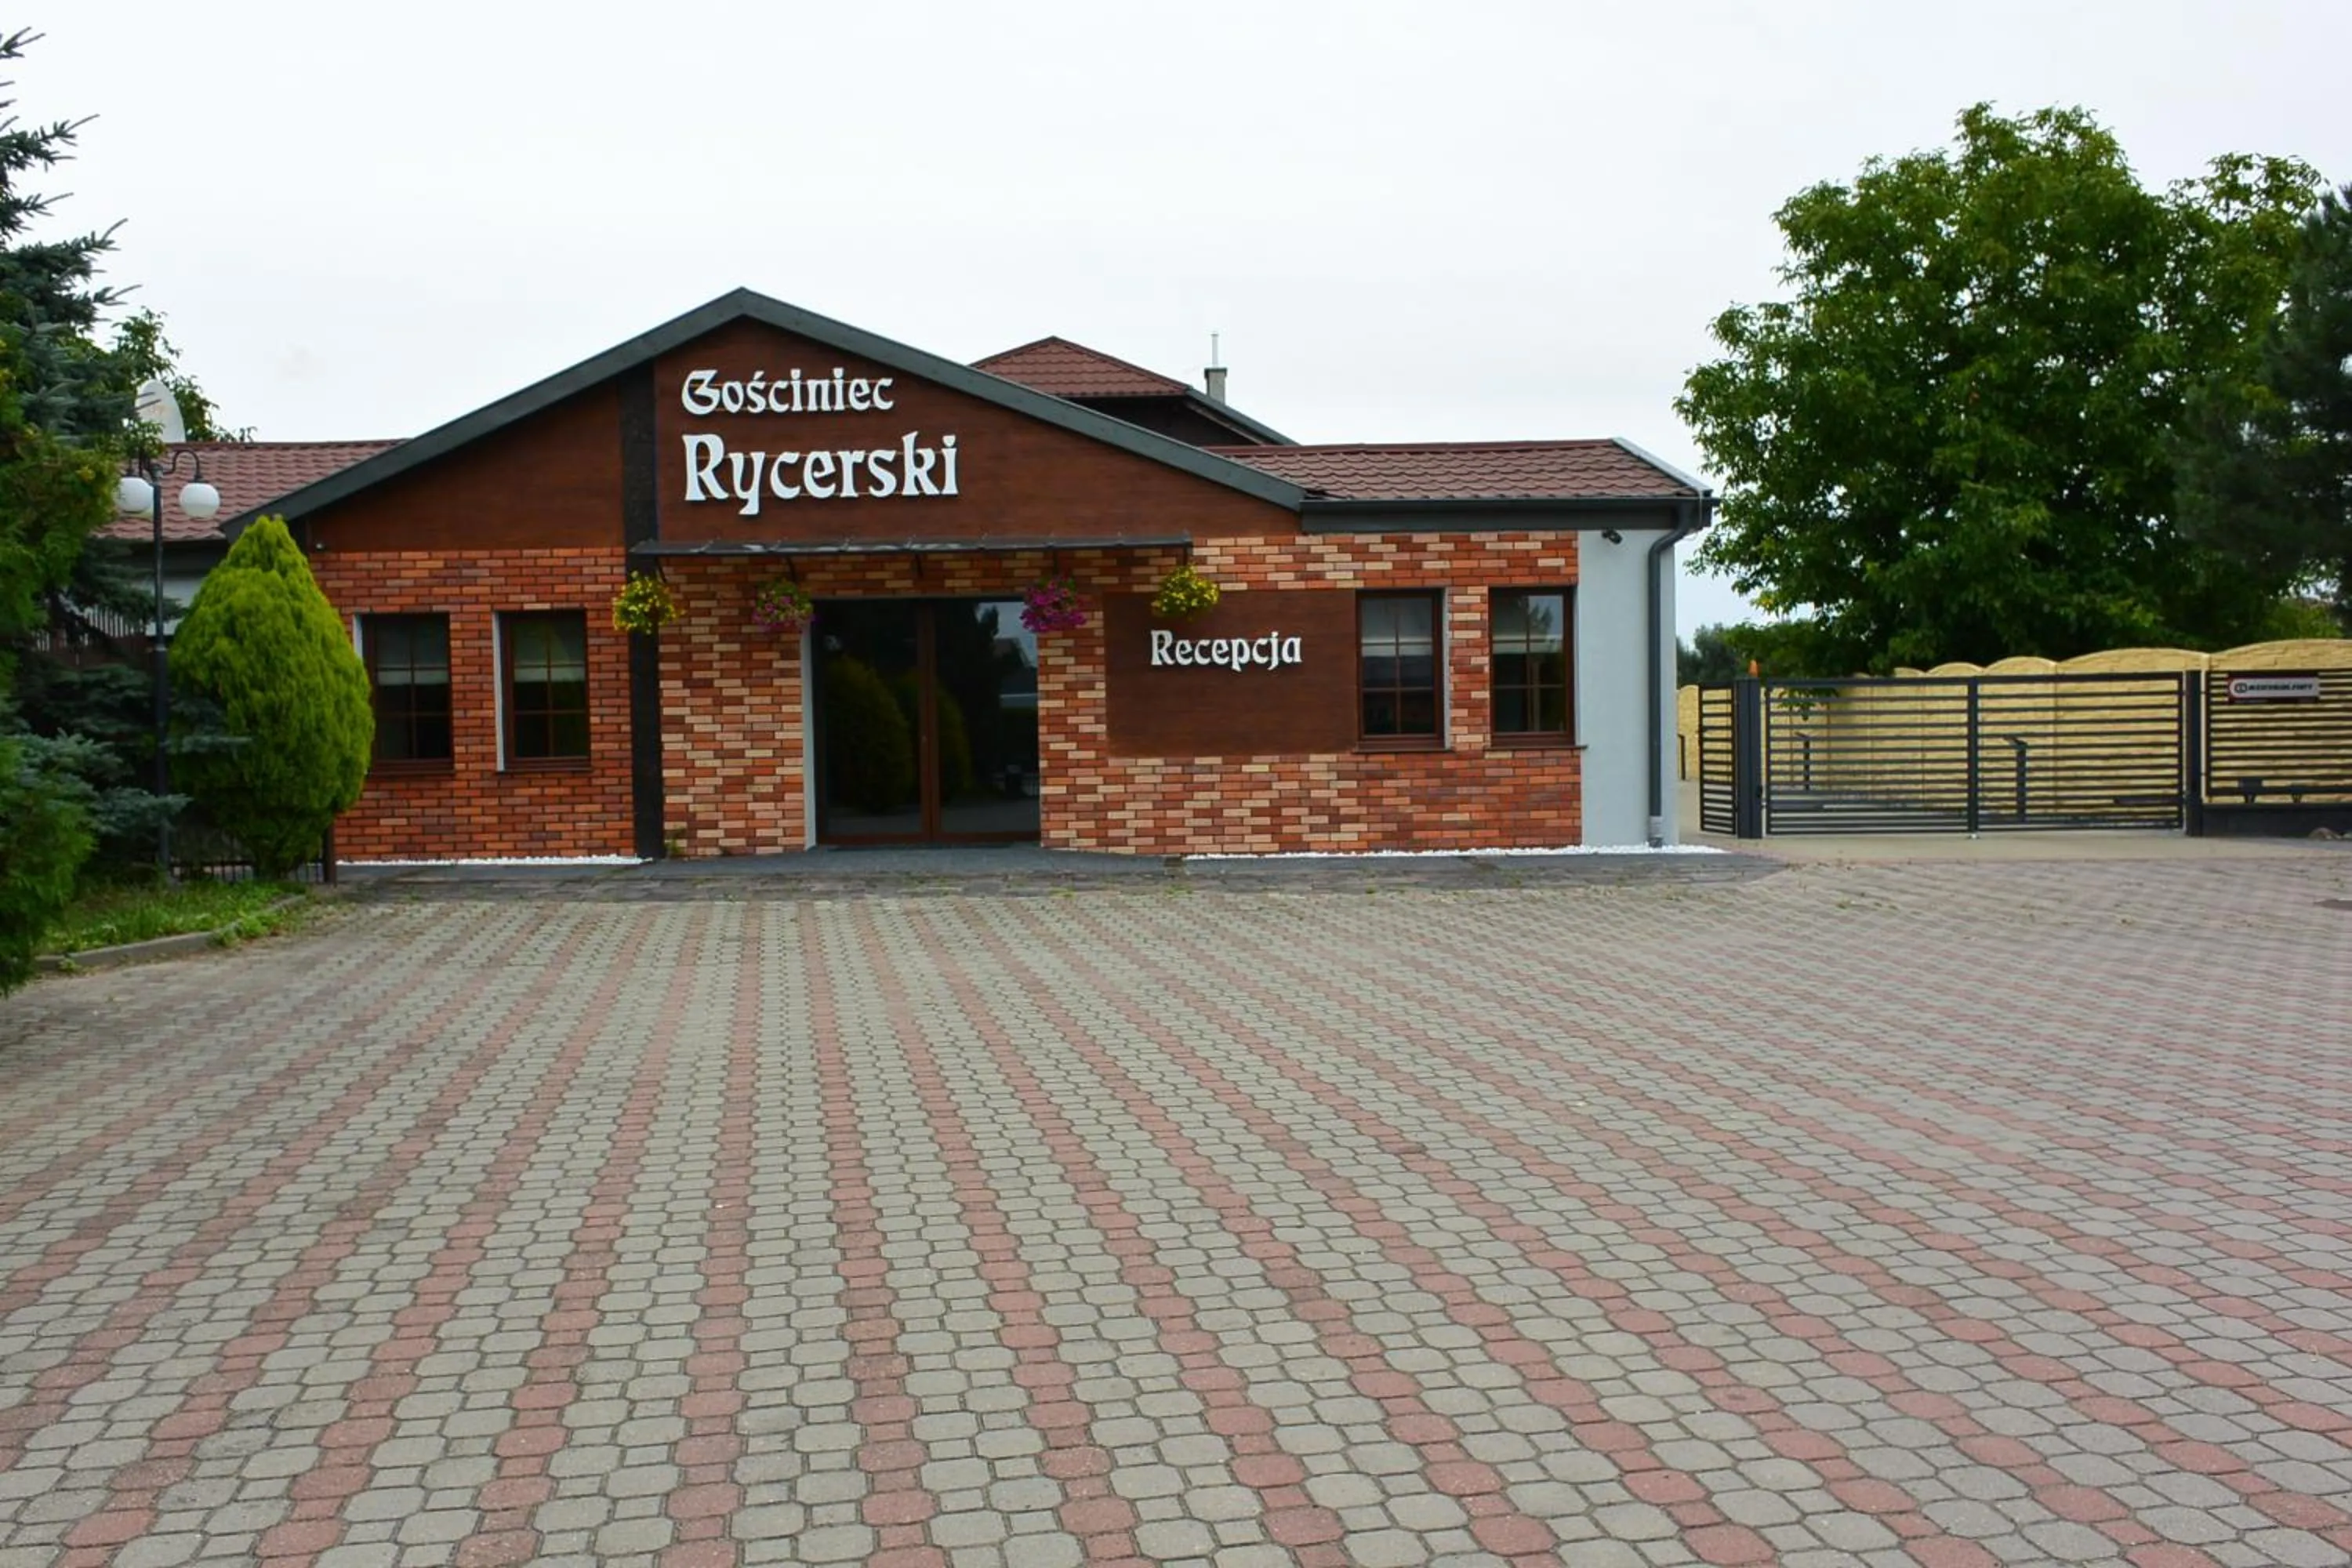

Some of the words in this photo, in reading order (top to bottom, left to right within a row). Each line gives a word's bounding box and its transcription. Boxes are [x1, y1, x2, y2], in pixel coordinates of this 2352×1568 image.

[681, 368, 894, 415] Gościniec
[682, 430, 959, 515] Rycerski
[1150, 630, 1302, 672] Recepcja
